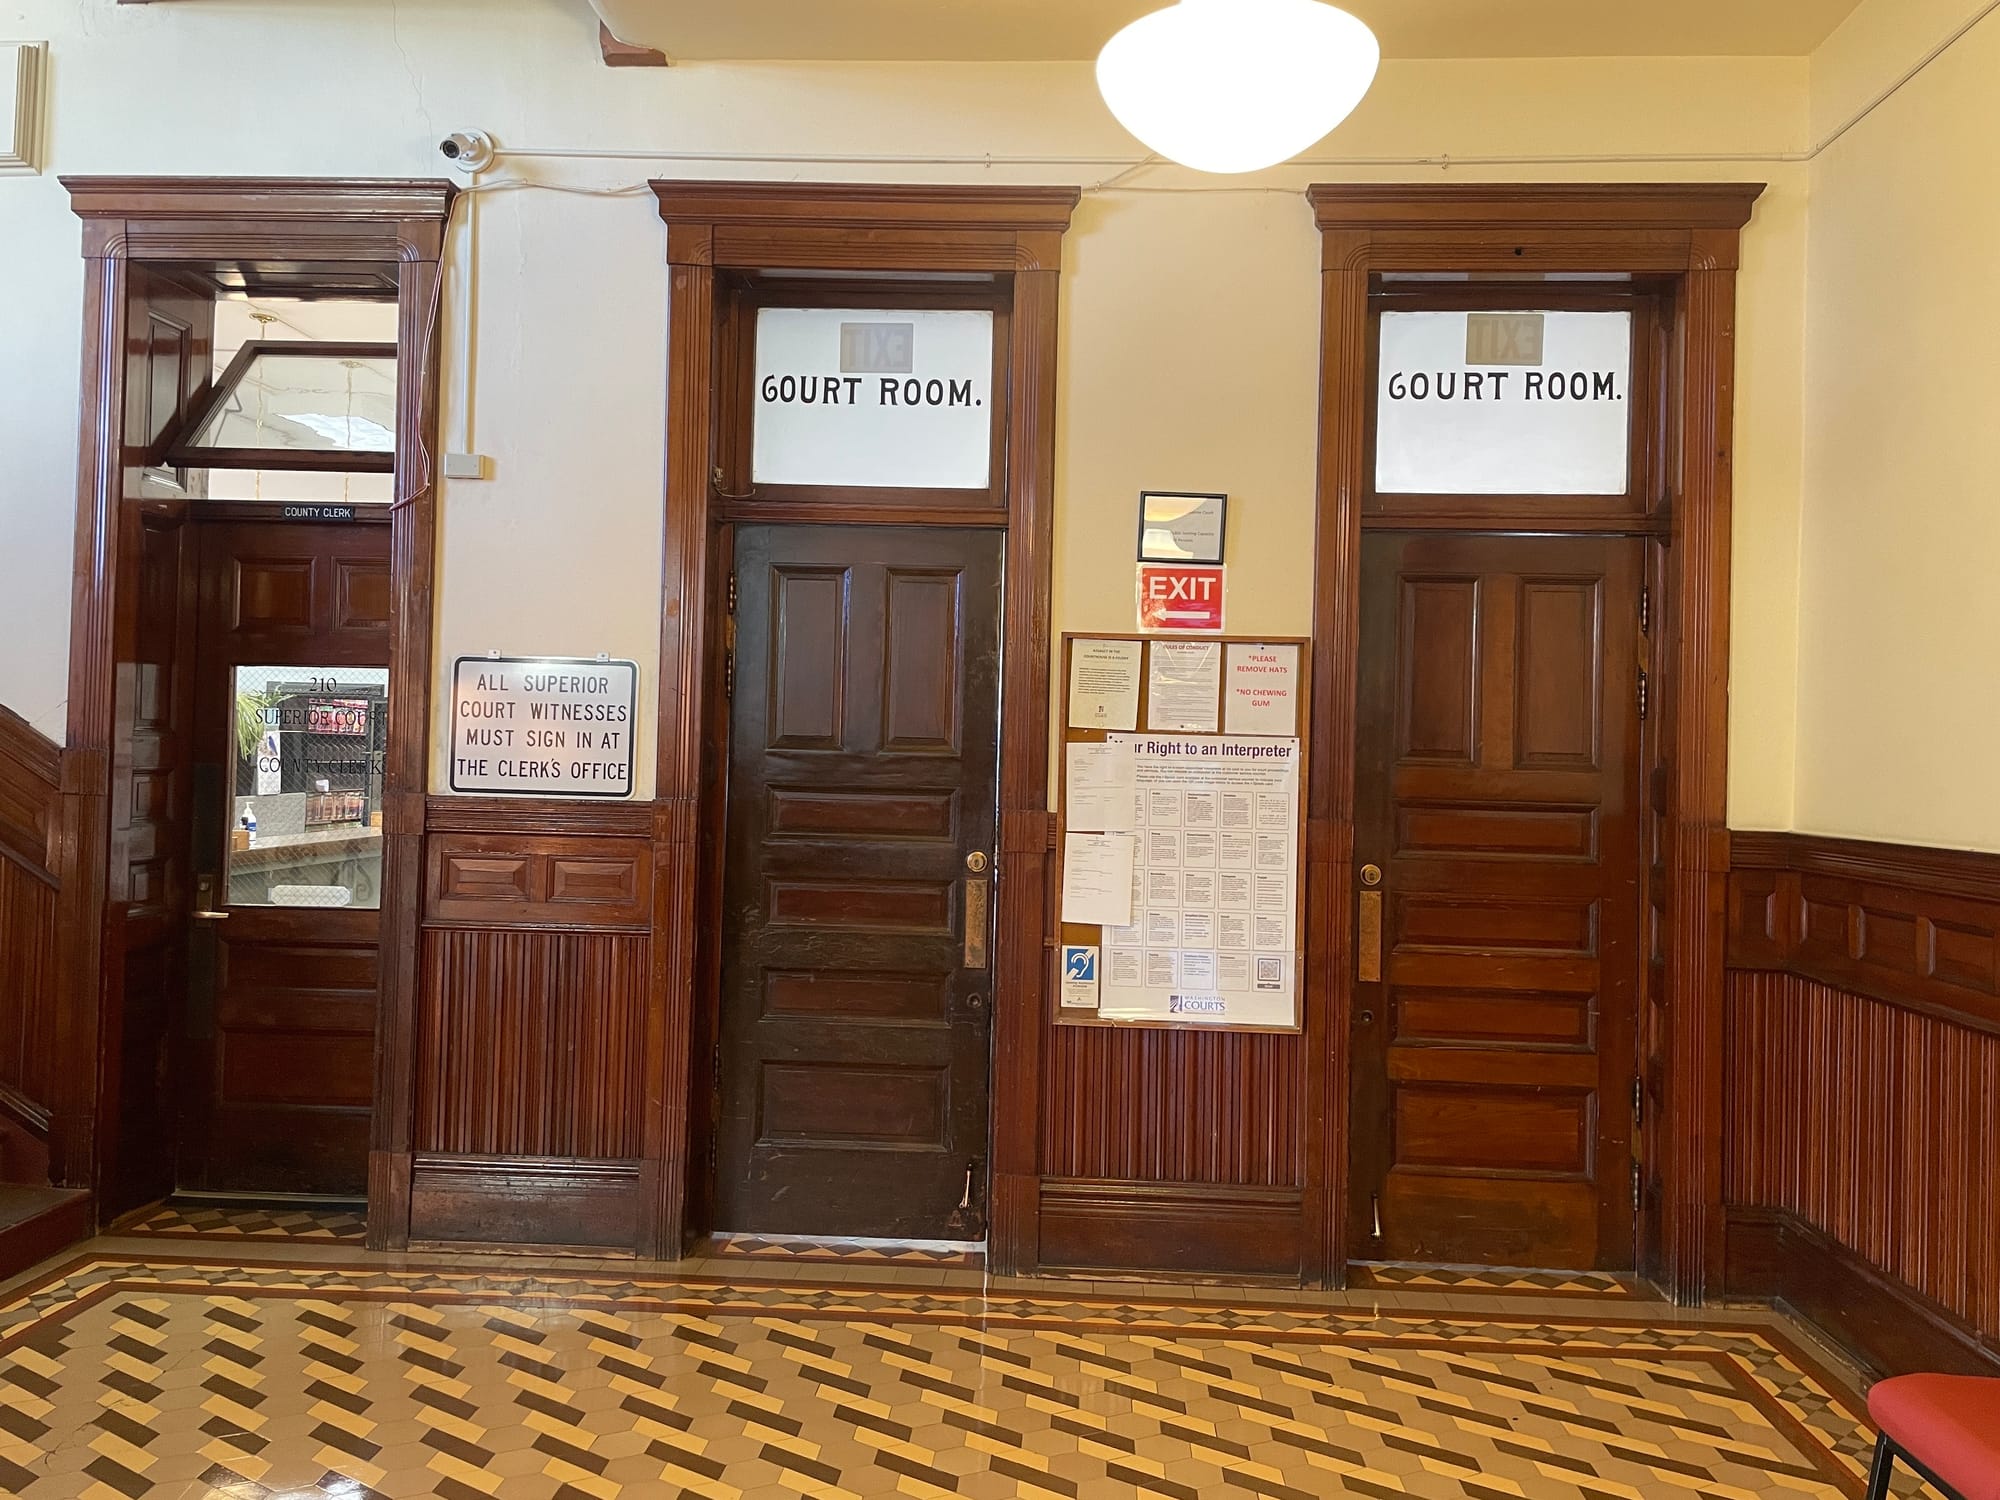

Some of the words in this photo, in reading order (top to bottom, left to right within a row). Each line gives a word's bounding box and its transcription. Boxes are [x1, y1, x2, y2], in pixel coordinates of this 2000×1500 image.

[761, 374, 862, 404] COURT
[879, 378, 982, 407] ROOM.
[1388, 371, 1509, 400] COURT
[1524, 372, 1622, 401] ROOM.
[284, 507, 320, 517] COUNTY
[323, 507, 351, 518] CLERK
[1149, 576, 1217, 601] EXIT
[1236, 665, 1267, 673] REMOVE
[1269, 666, 1288, 674] HATS
[309, 677, 337, 692] 210
[477, 674, 509, 691] ALL
[524, 675, 608, 694] SUPERIOR
[1252, 689, 1287, 697] CHEWING
[255, 708, 330, 726] SUPERIOR
[460, 700, 516, 719] COURT
[530, 703, 627, 722] WITNESSES
[466, 728, 515, 747] MUST
[526, 730, 565, 748] SIGN
[576, 731, 592, 749] IN
[600, 732, 620, 749] AT
[1147, 741, 1181, 757] Right
[1185, 743, 1197, 755] to
[1201, 744, 1217, 756] an
[1222, 743, 1292, 759] Interpreter
[259, 757, 322, 774] COUNTY
[328, 758, 382, 775] CLERK
[457, 758, 489, 776] THE
[498, 758, 561, 778] CLERK'S
[570, 761, 627, 780] OFFICE
[1184, 1000, 1226, 1011] COURTS
